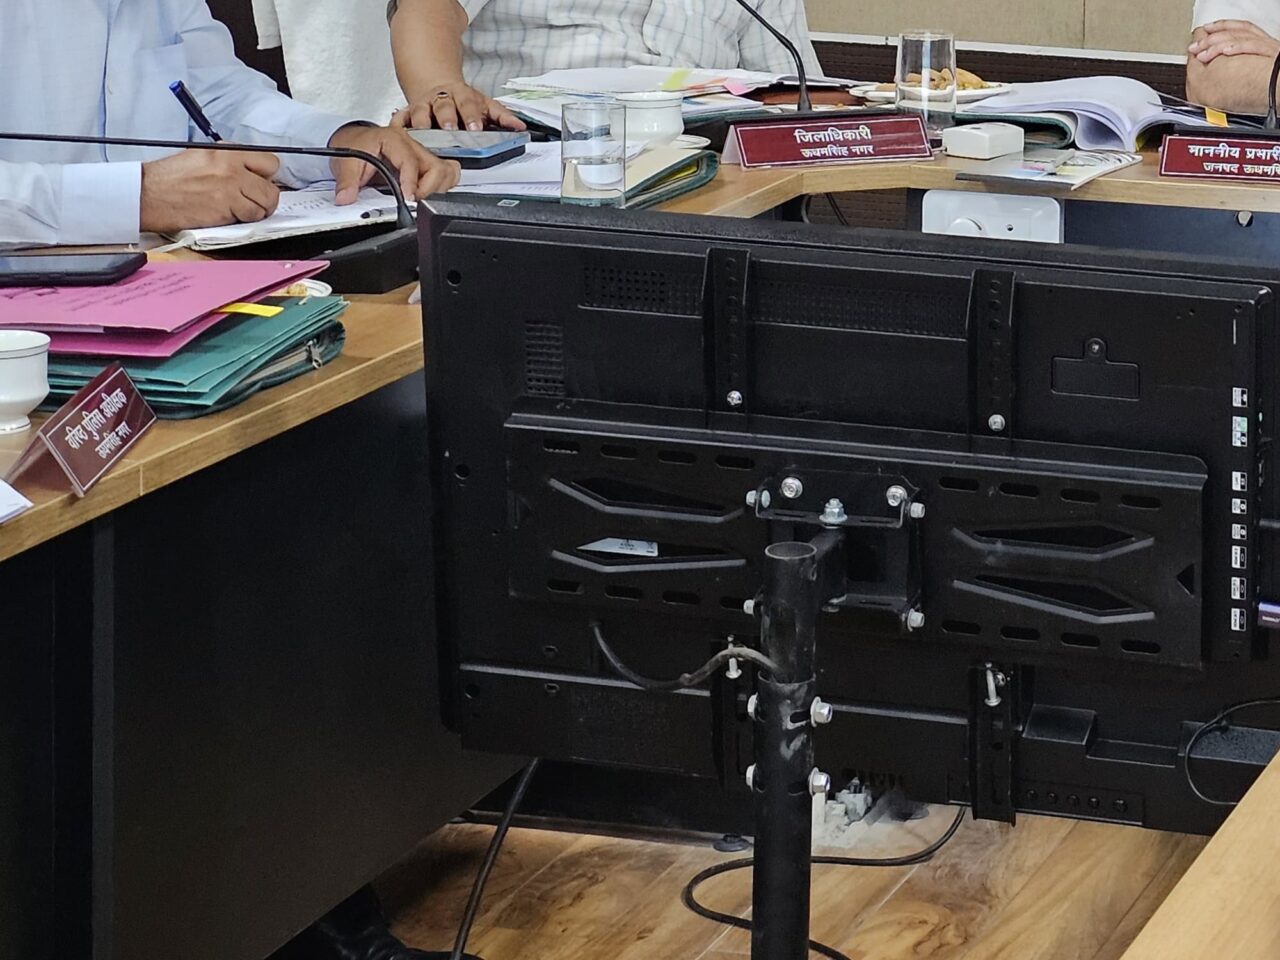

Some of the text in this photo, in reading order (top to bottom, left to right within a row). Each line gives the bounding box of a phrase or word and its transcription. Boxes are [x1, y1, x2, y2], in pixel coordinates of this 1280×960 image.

[794, 125, 872, 143] जिलाधिकारी
[850, 145, 874, 155] नगर
[1188, 143, 1240, 158] माननीय
[1203, 162, 1239, 173] जनपद
[81, 409, 106, 440] पुलिस
